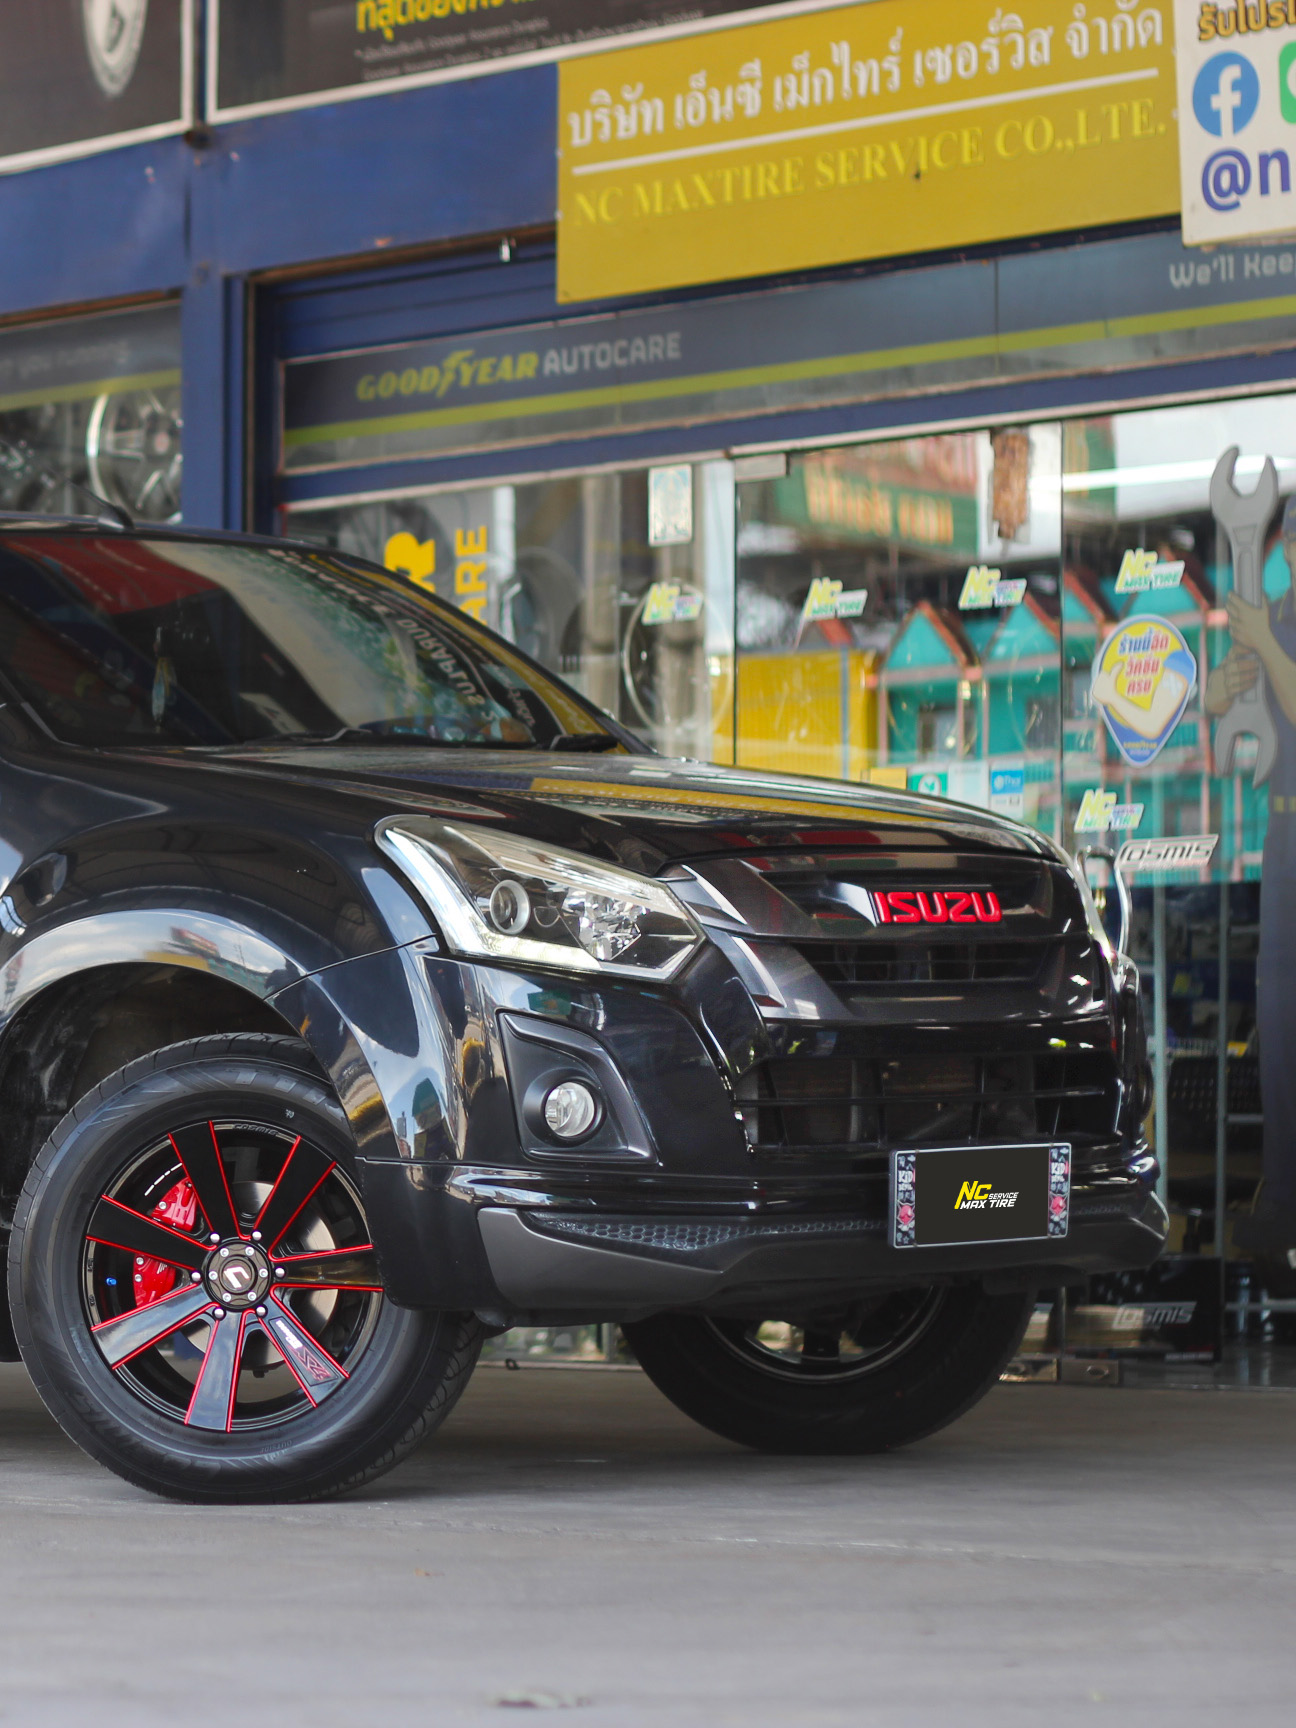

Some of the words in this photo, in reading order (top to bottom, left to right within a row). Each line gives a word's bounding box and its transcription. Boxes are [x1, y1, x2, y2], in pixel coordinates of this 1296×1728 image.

[569, 83, 664, 148] บริษัท
[674, 58, 762, 129] เอ็นซี
[913, 7, 1054, 87] เซอร์วิส
[1065, 0, 1163, 59] จำกัด
[574, 186, 623, 227] NC
[632, 156, 804, 217] MAXTIRE
[815, 127, 984, 188] SERVICE
[1169, 253, 1234, 289] We'll
[1244, 251, 1296, 279] Kee
[357, 350, 539, 401] GOODYEAR
[543, 332, 682, 376] AUTOCARE
[874, 890, 1002, 923] ISUZU
